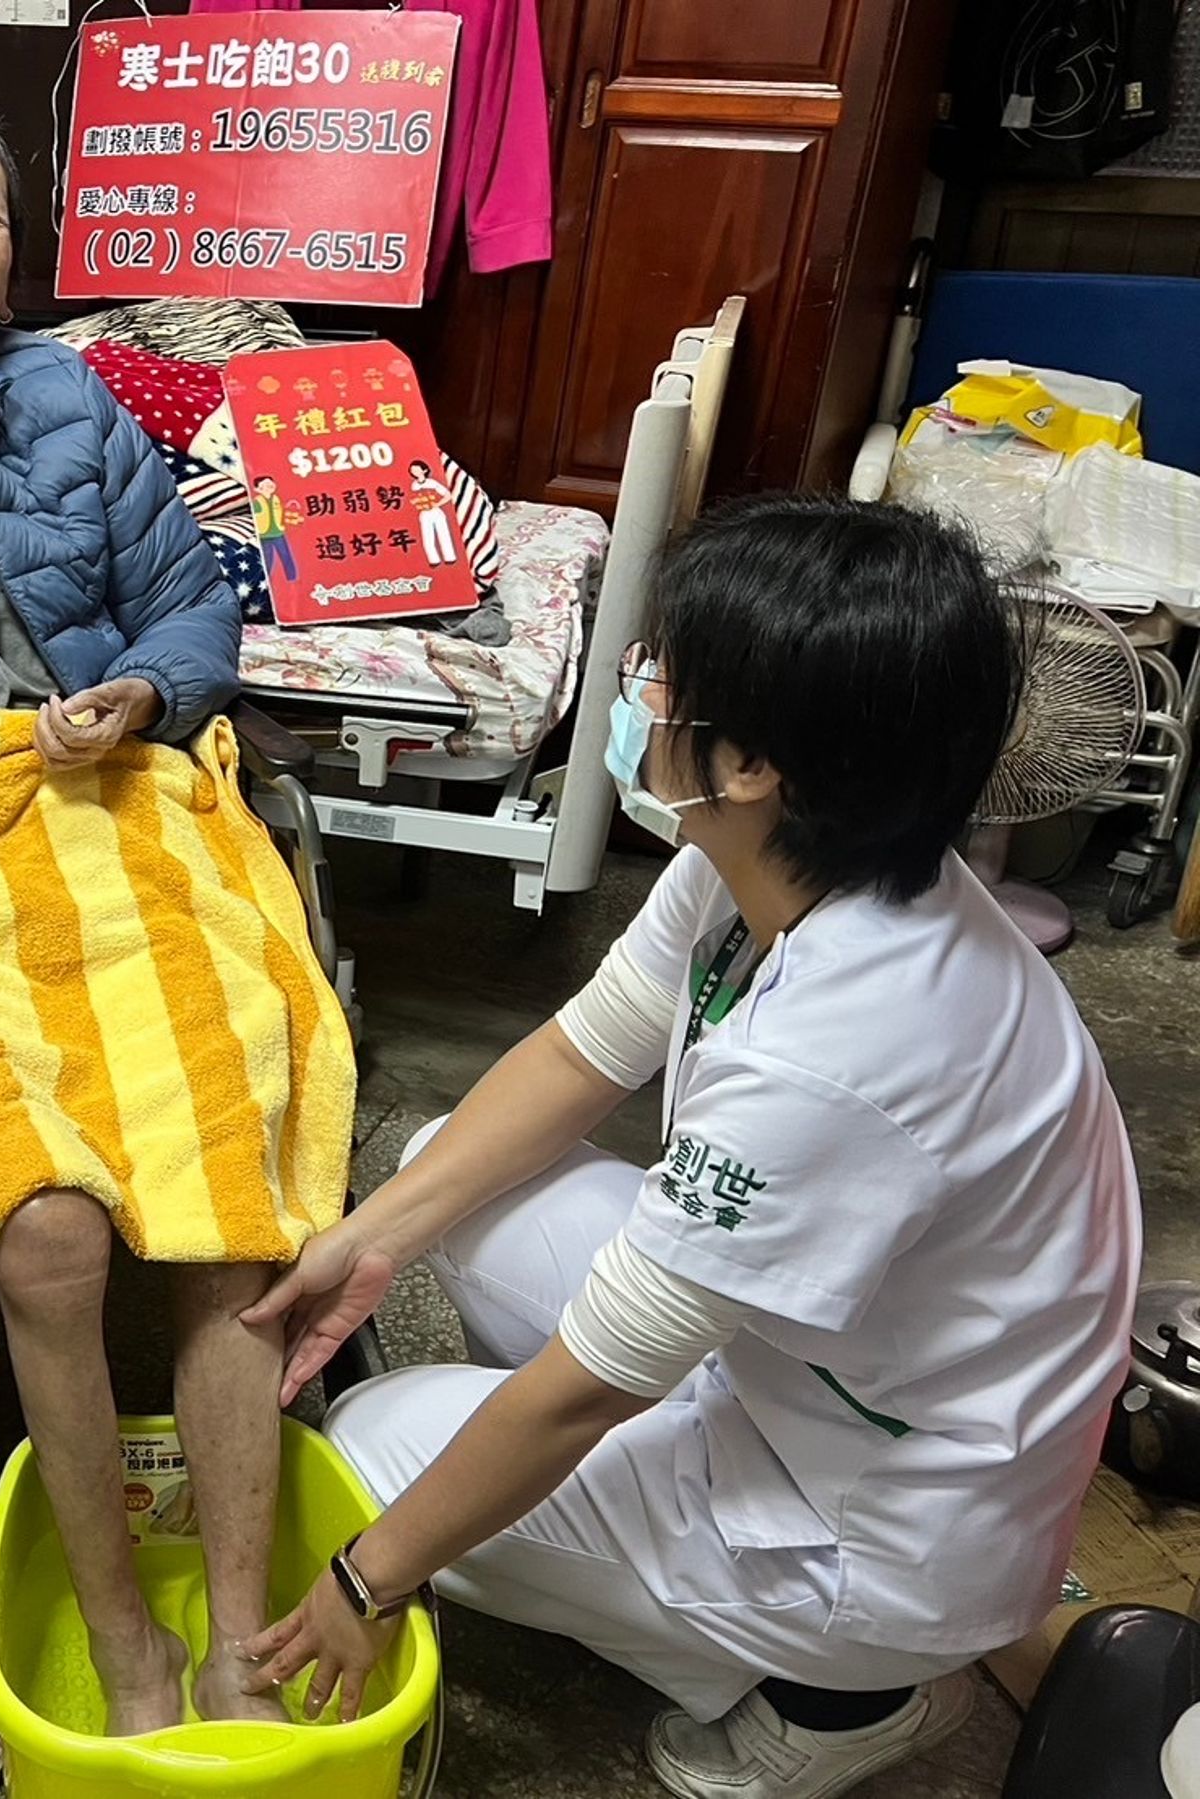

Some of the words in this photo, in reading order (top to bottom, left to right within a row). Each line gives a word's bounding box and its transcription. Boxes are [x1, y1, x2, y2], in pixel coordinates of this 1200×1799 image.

[117, 37, 351, 92] 寒士吃飽30
[253, 402, 410, 439] 年禮紅包
[288, 441, 394, 478] $1200
[305, 485, 406, 518] 助弱勢
[315, 529, 417, 561] 過好年
[668, 1135, 767, 1206] 創世
